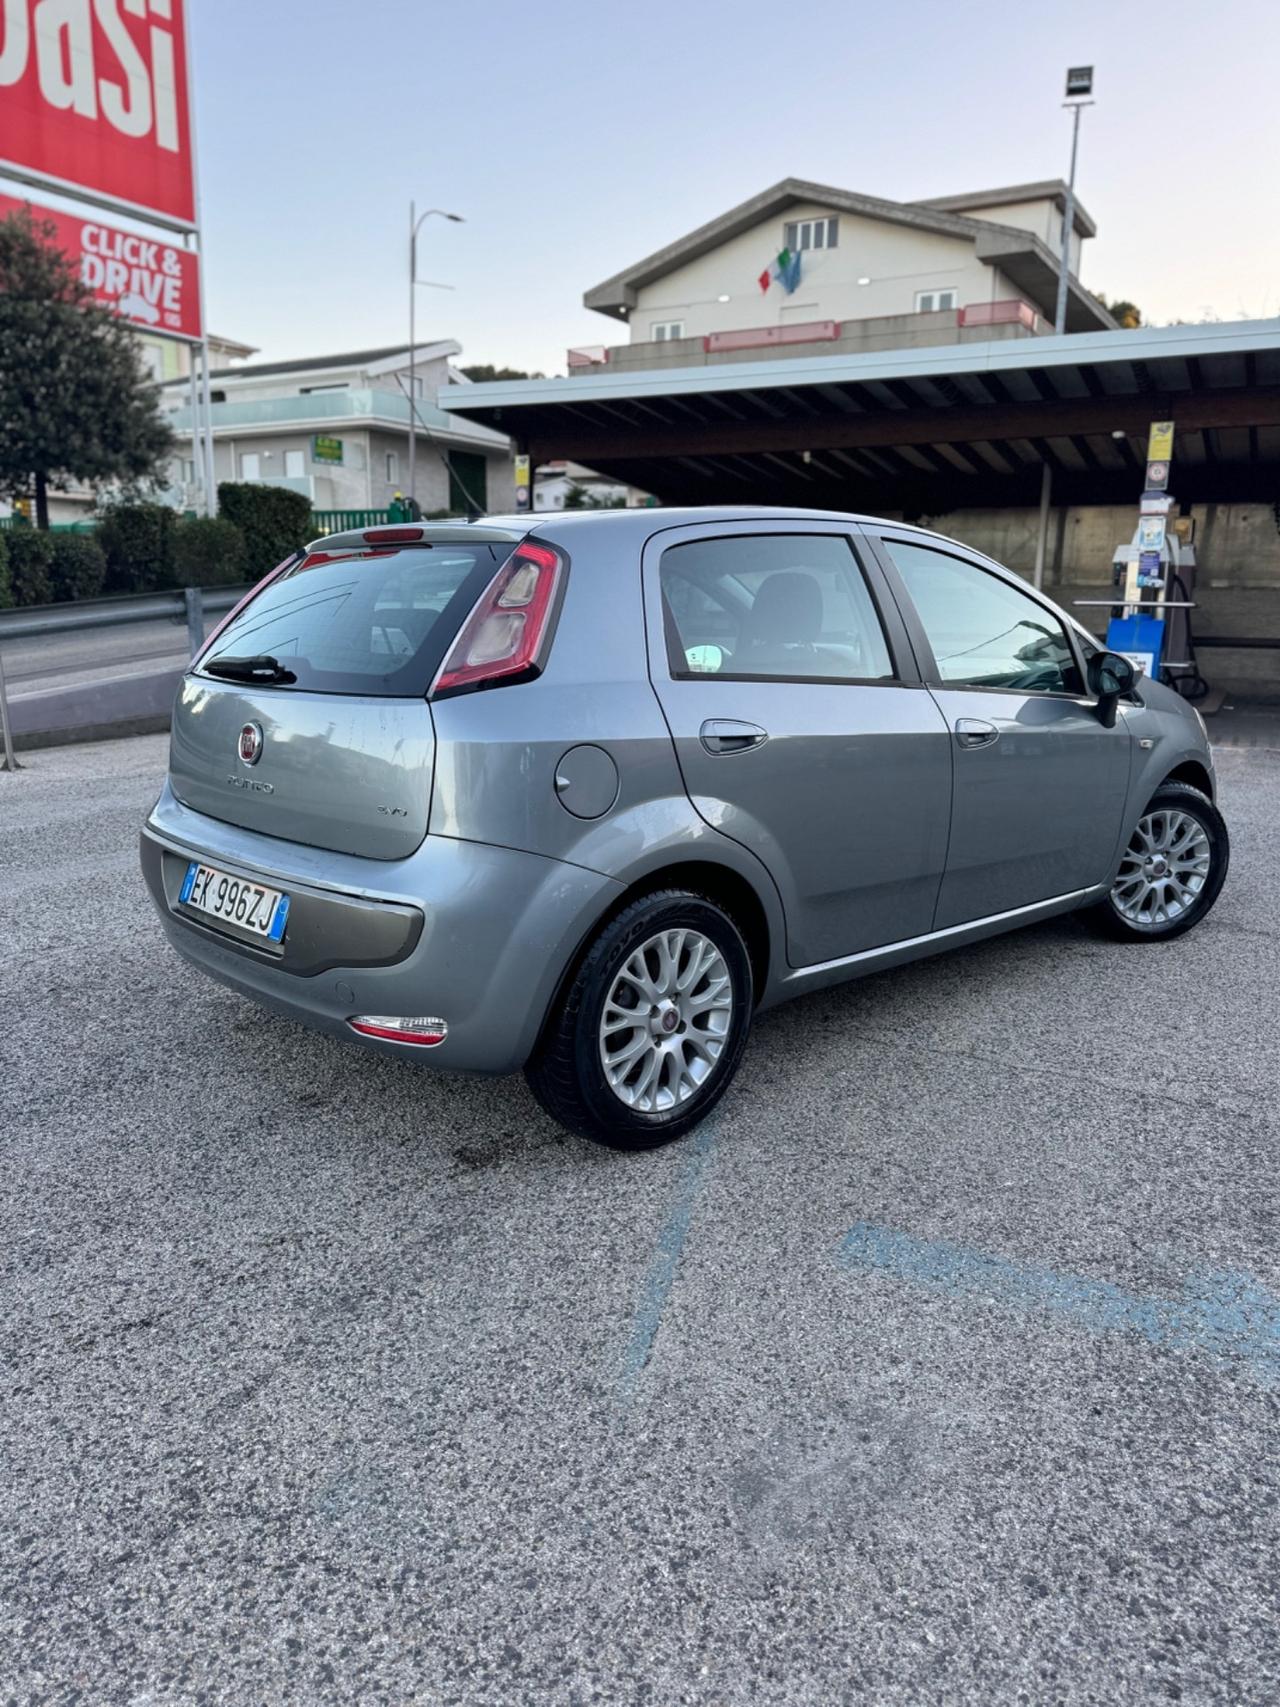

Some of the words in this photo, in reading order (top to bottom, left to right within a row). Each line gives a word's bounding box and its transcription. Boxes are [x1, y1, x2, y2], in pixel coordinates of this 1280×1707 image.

[80, 224, 159, 270] CLICK
[161, 247, 182, 277] &
[80, 252, 182, 312] DRIVE
[190, 868, 215, 908] EK
[214, 877, 278, 932] 996ZJ
